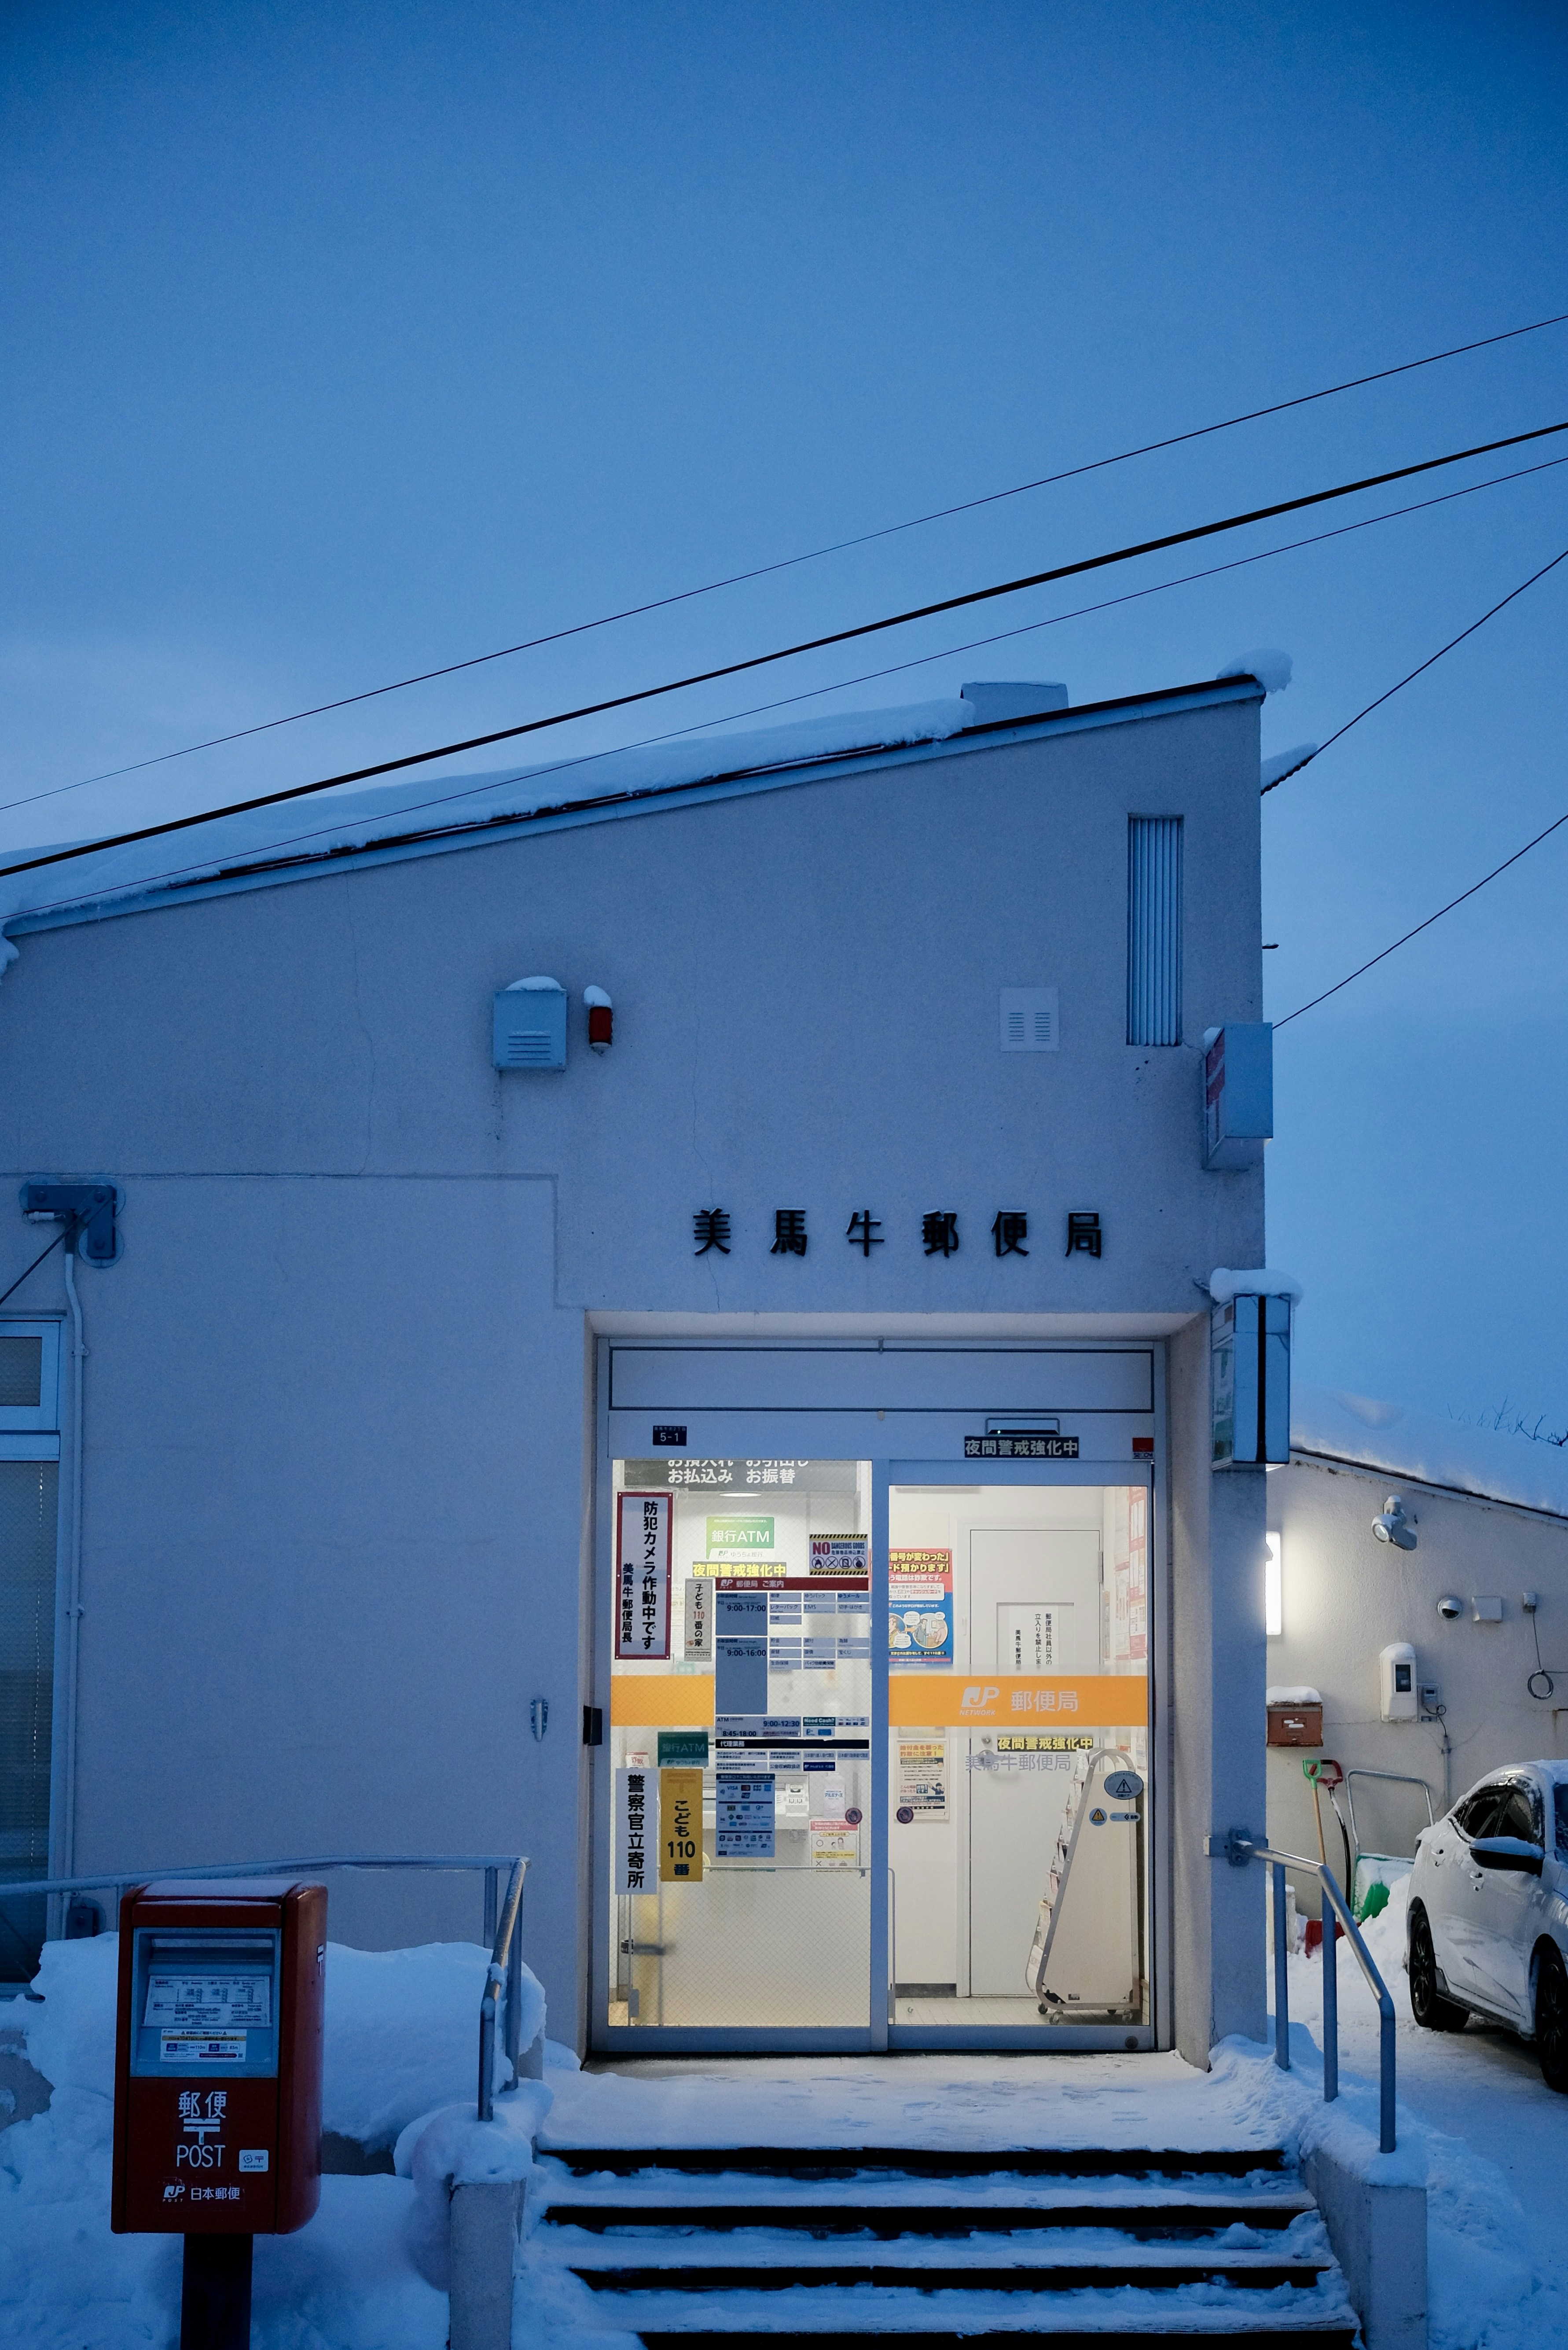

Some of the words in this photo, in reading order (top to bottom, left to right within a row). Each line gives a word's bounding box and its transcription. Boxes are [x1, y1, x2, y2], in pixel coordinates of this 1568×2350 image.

[693, 1208, 1101, 1258] 美馬牛郵便局
[660, 1433, 678, 1442] 5-1
[966, 1440, 1077, 1456] 夜間警戒強化中
[668, 1469, 733, 1484] お払込み
[746, 1469, 795, 1484] お振替
[712, 1530, 769, 1542] 銀行ATM
[813, 1542, 830, 1555] NO
[889, 1552, 949, 1562] 番号が変わった」
[642, 1501, 658, 1650] 防犯カメラ作動中です
[693, 1563, 786, 1577] 夜間警戒強化中
[622, 1563, 634, 1643] 美馬牛郵便局長
[694, 1584, 705, 1647] 子ども110番の家
[1011, 1691, 1078, 1712] 郵便局
[662, 1743, 704, 1752] 銀行ATM
[998, 1737, 1093, 1749] 夜間警戒強化中
[966, 1754, 1071, 1771] 美馬牛郵便局
[628, 1774, 645, 1888] 警察官立寄所
[668, 1800, 695, 1875] こども110番
[178, 2091, 228, 2118] 郵便
[176, 2145, 226, 2167] POST
[191, 2187, 240, 2200] 日本郵便
